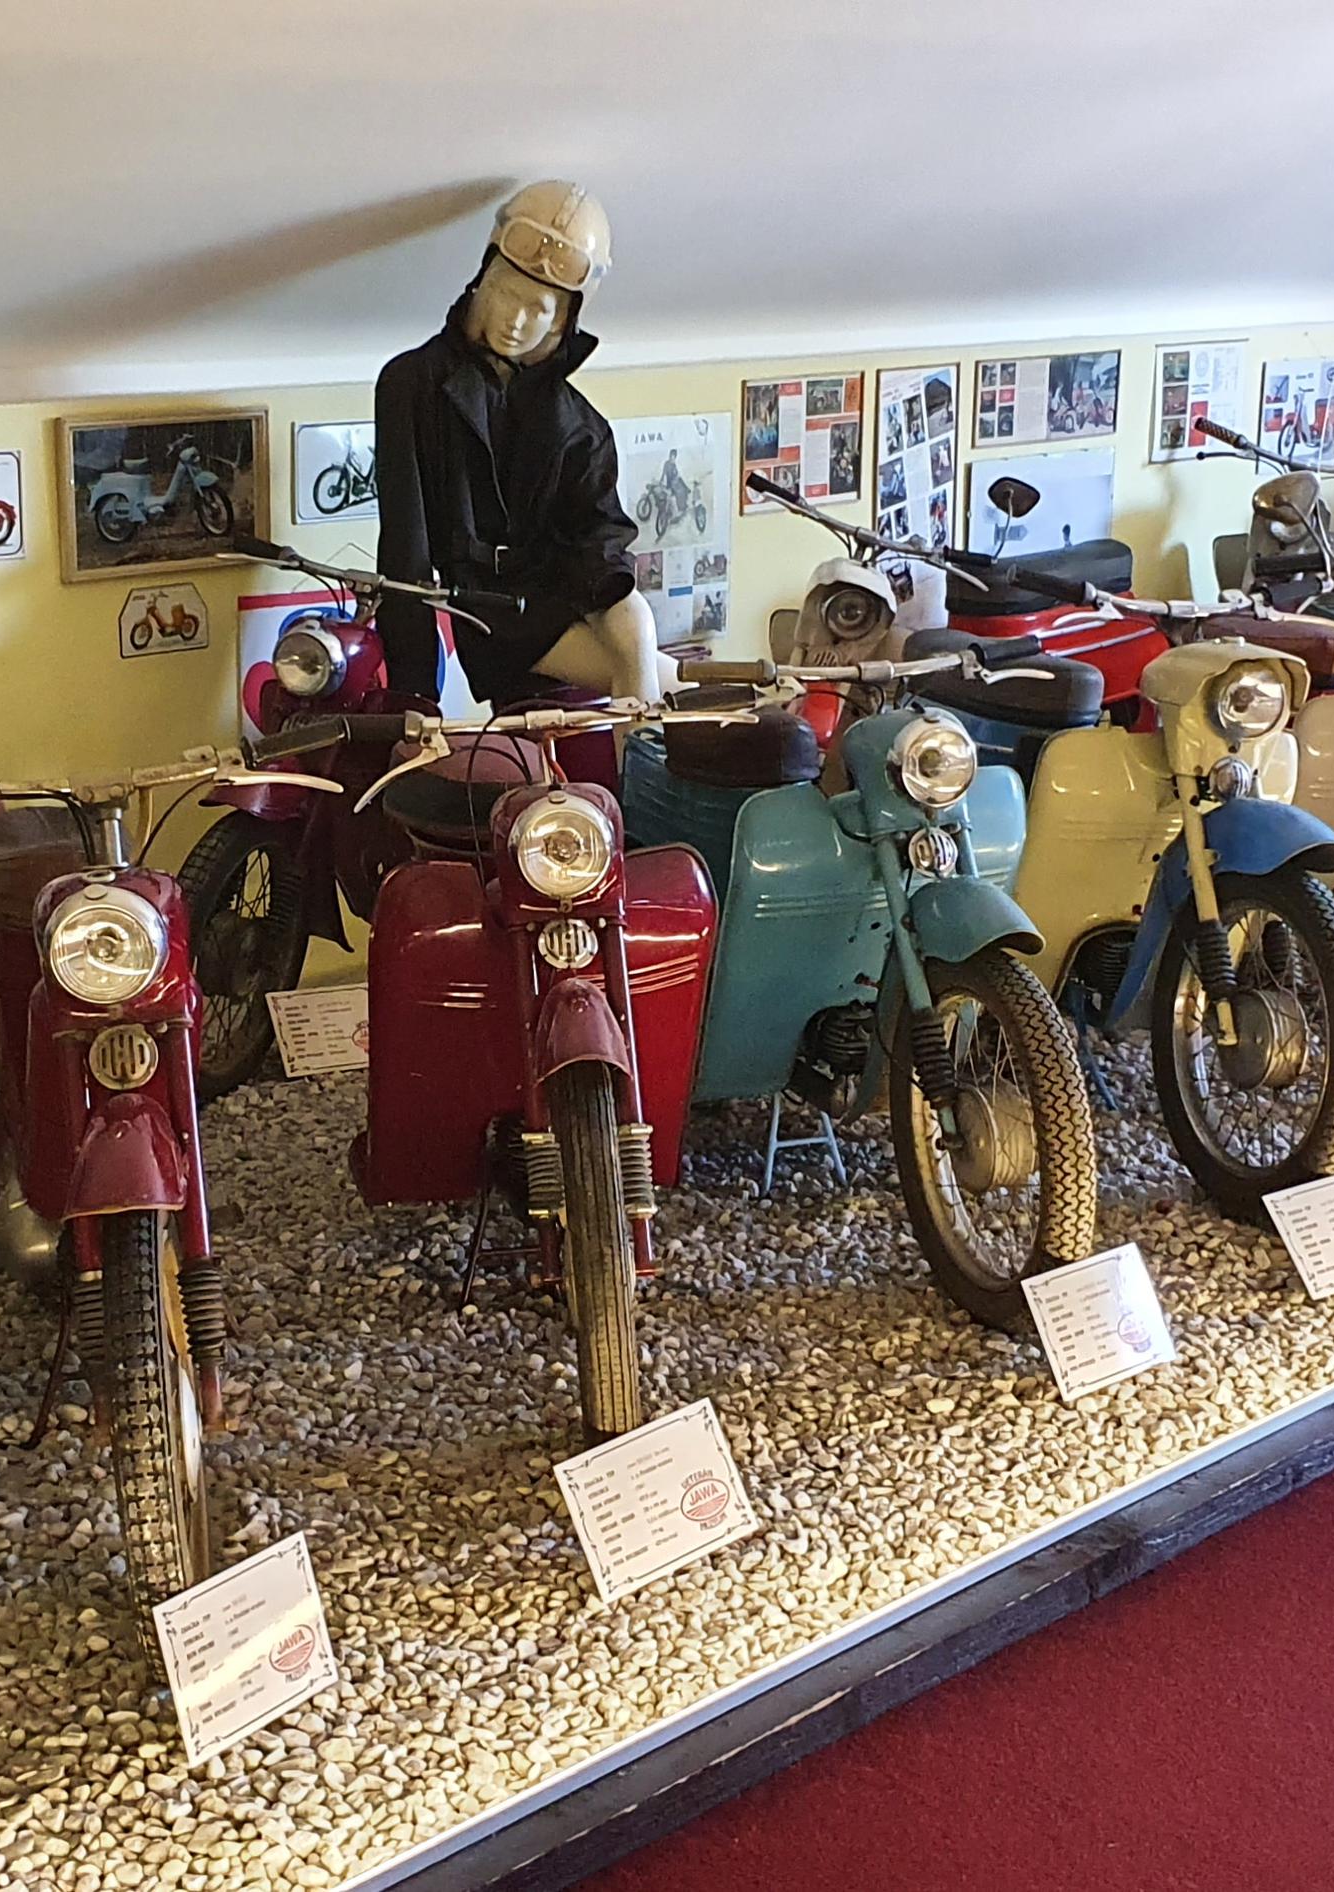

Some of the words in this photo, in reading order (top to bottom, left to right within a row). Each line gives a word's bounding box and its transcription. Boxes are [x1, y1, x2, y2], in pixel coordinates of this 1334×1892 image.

[635, 433, 663, 444] JAWA
[689, 1482, 719, 1506] JAWA
[276, 1629, 306, 1655] JAWA
